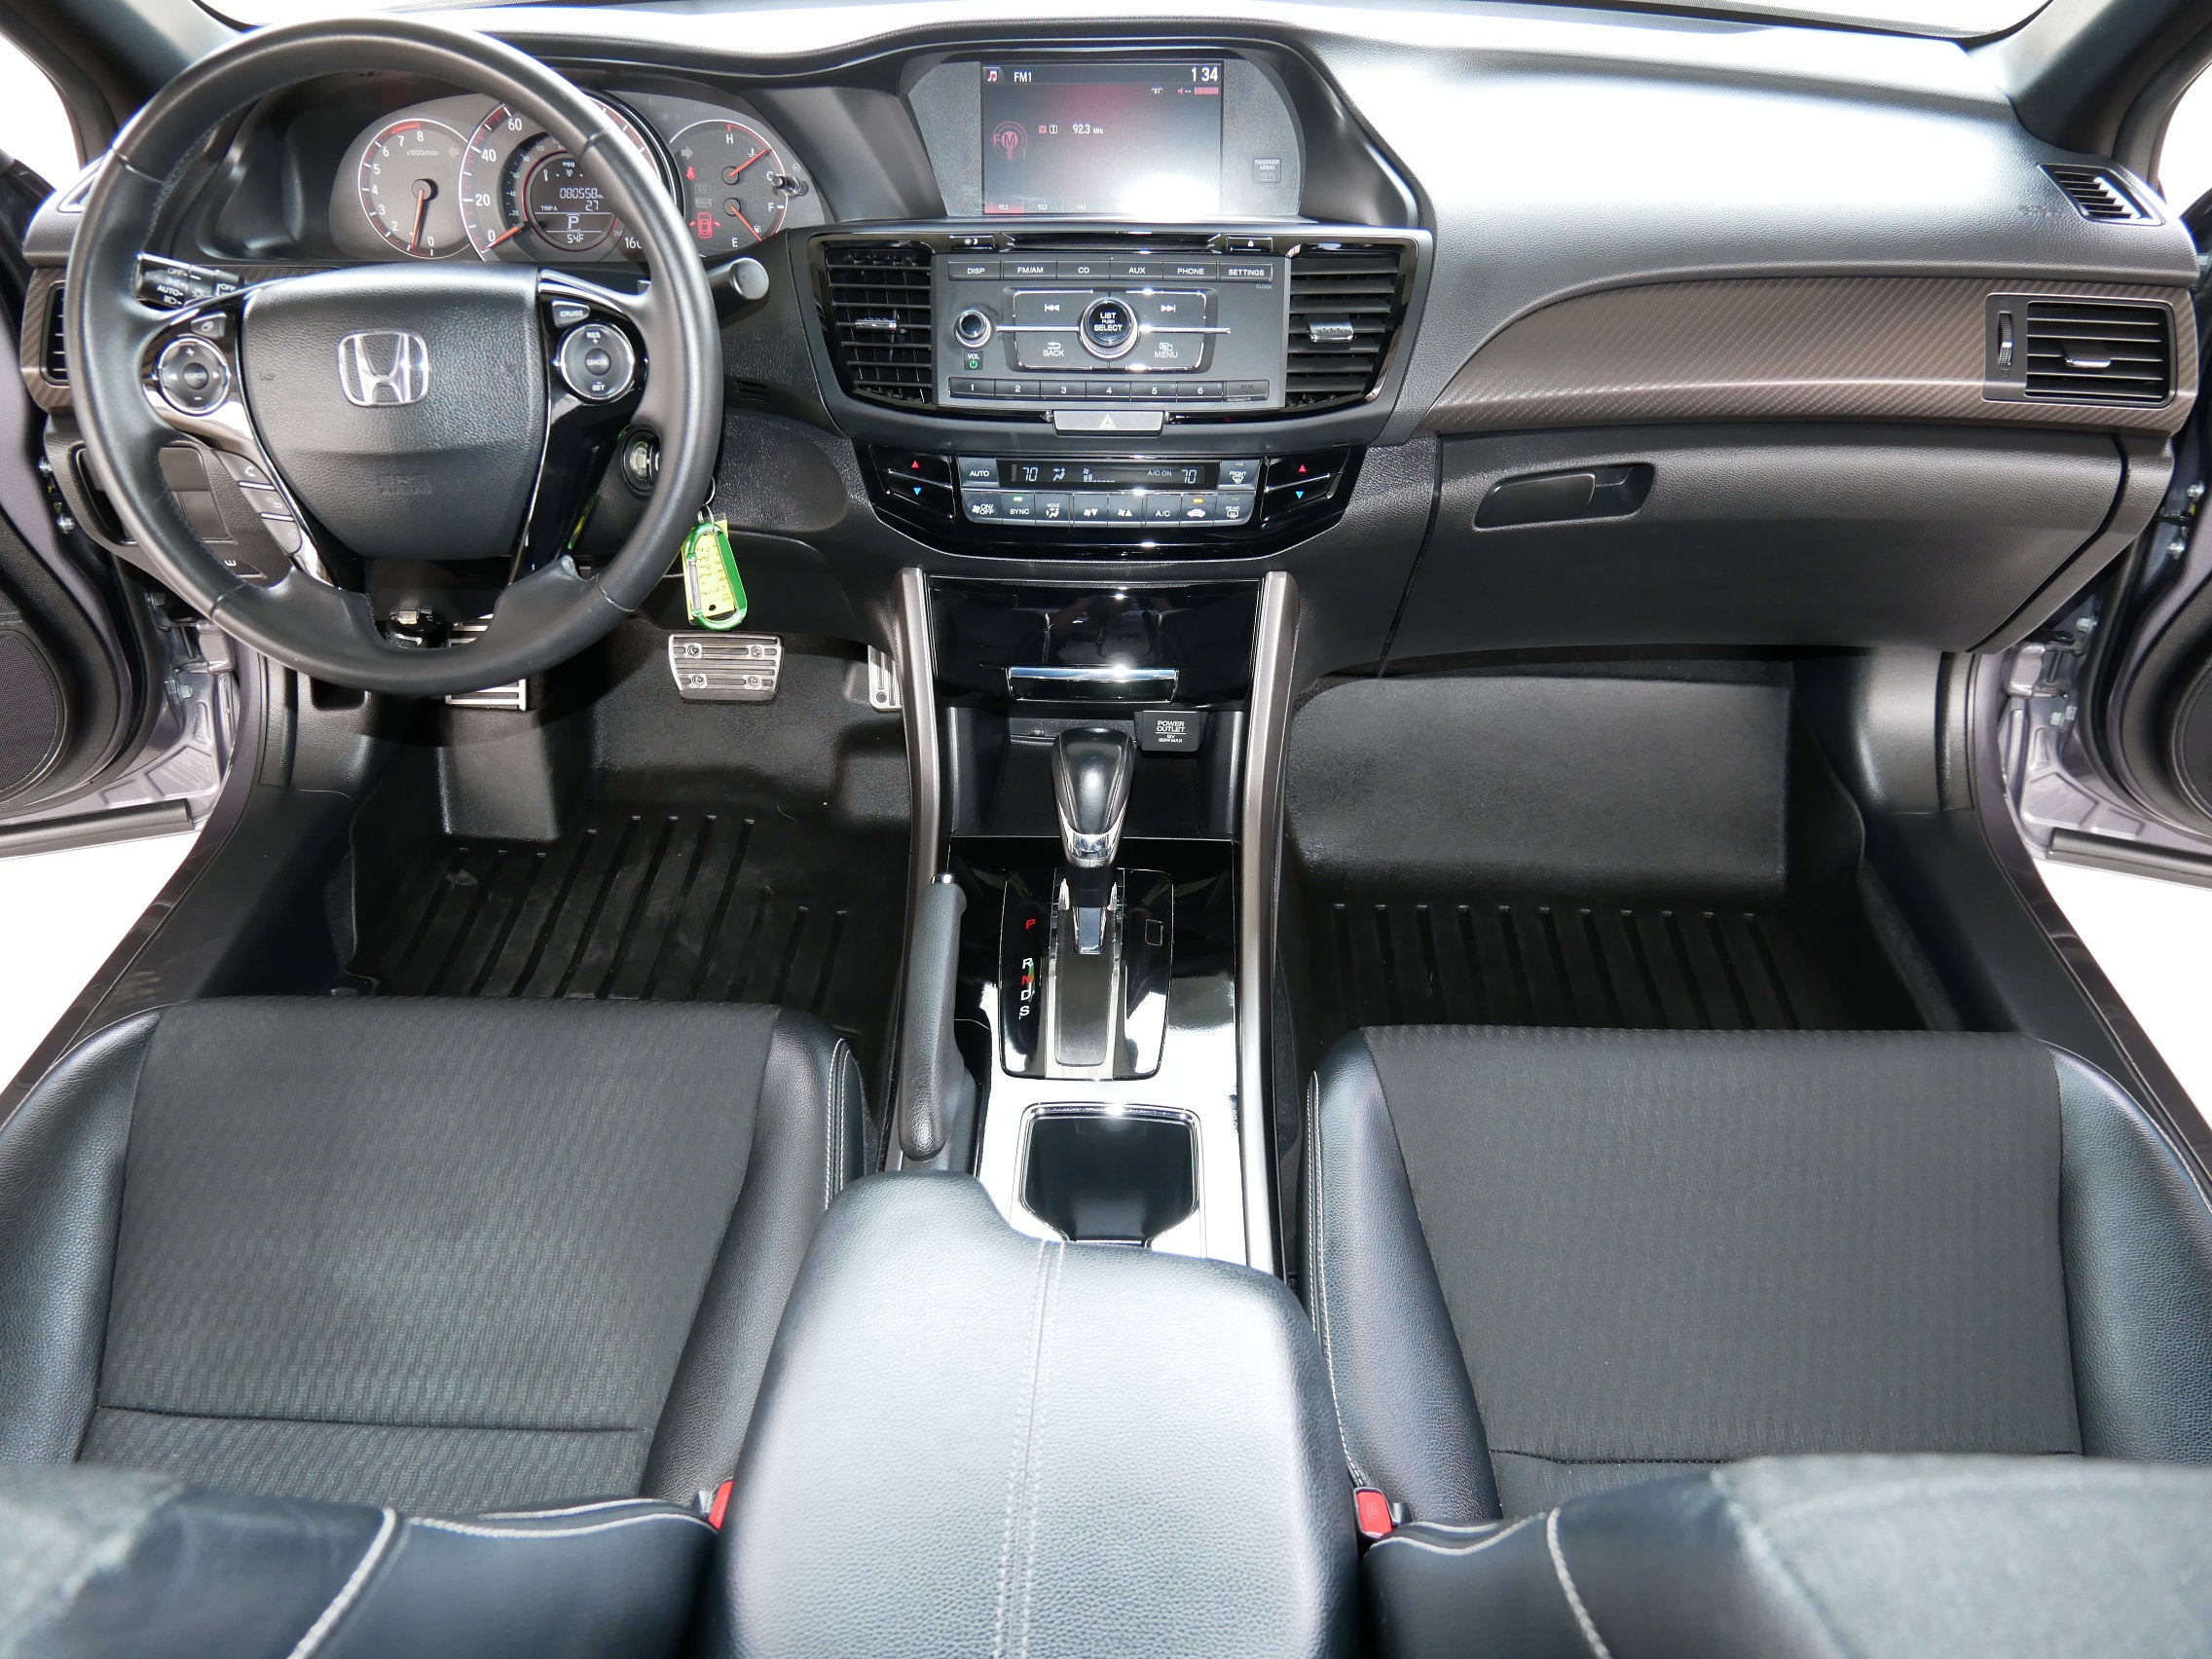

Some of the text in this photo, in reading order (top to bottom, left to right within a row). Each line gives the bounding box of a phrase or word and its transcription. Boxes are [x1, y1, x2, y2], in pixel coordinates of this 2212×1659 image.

[1014, 71, 1032, 83] FM1
[508, 118, 522, 130] 60
[1073, 125, 1090, 134] 92.3
[398, 136, 404, 146] 7
[417, 131, 424, 142] 8
[726, 134, 733, 144] H
[383, 147, 389, 157] 6
[481, 149, 497, 162] 40
[373, 165, 381, 174] 5
[766, 171, 774, 181] C
[372, 185, 379, 195] 4
[560, 188, 598, 200] 080558
[476, 194, 491, 206] 20
[379, 204, 386, 215] 3
[768, 203, 774, 212] F
[391, 221, 398, 231] 2
[569, 215, 579, 229] P
[488, 230, 496, 241] 0
[427, 237, 434, 246] 0
[732, 238, 738, 247] E
[167, 267, 184, 276] OFF
[157, 284, 179, 296] AUTO
[1022, 466, 1039, 481] 70
[1181, 469, 1197, 484] 70
[1025, 919, 1037, 930] P
[1022, 957, 1034, 970] R
[1020, 989, 1032, 1001] D
[1019, 1005, 1030, 1016] S
